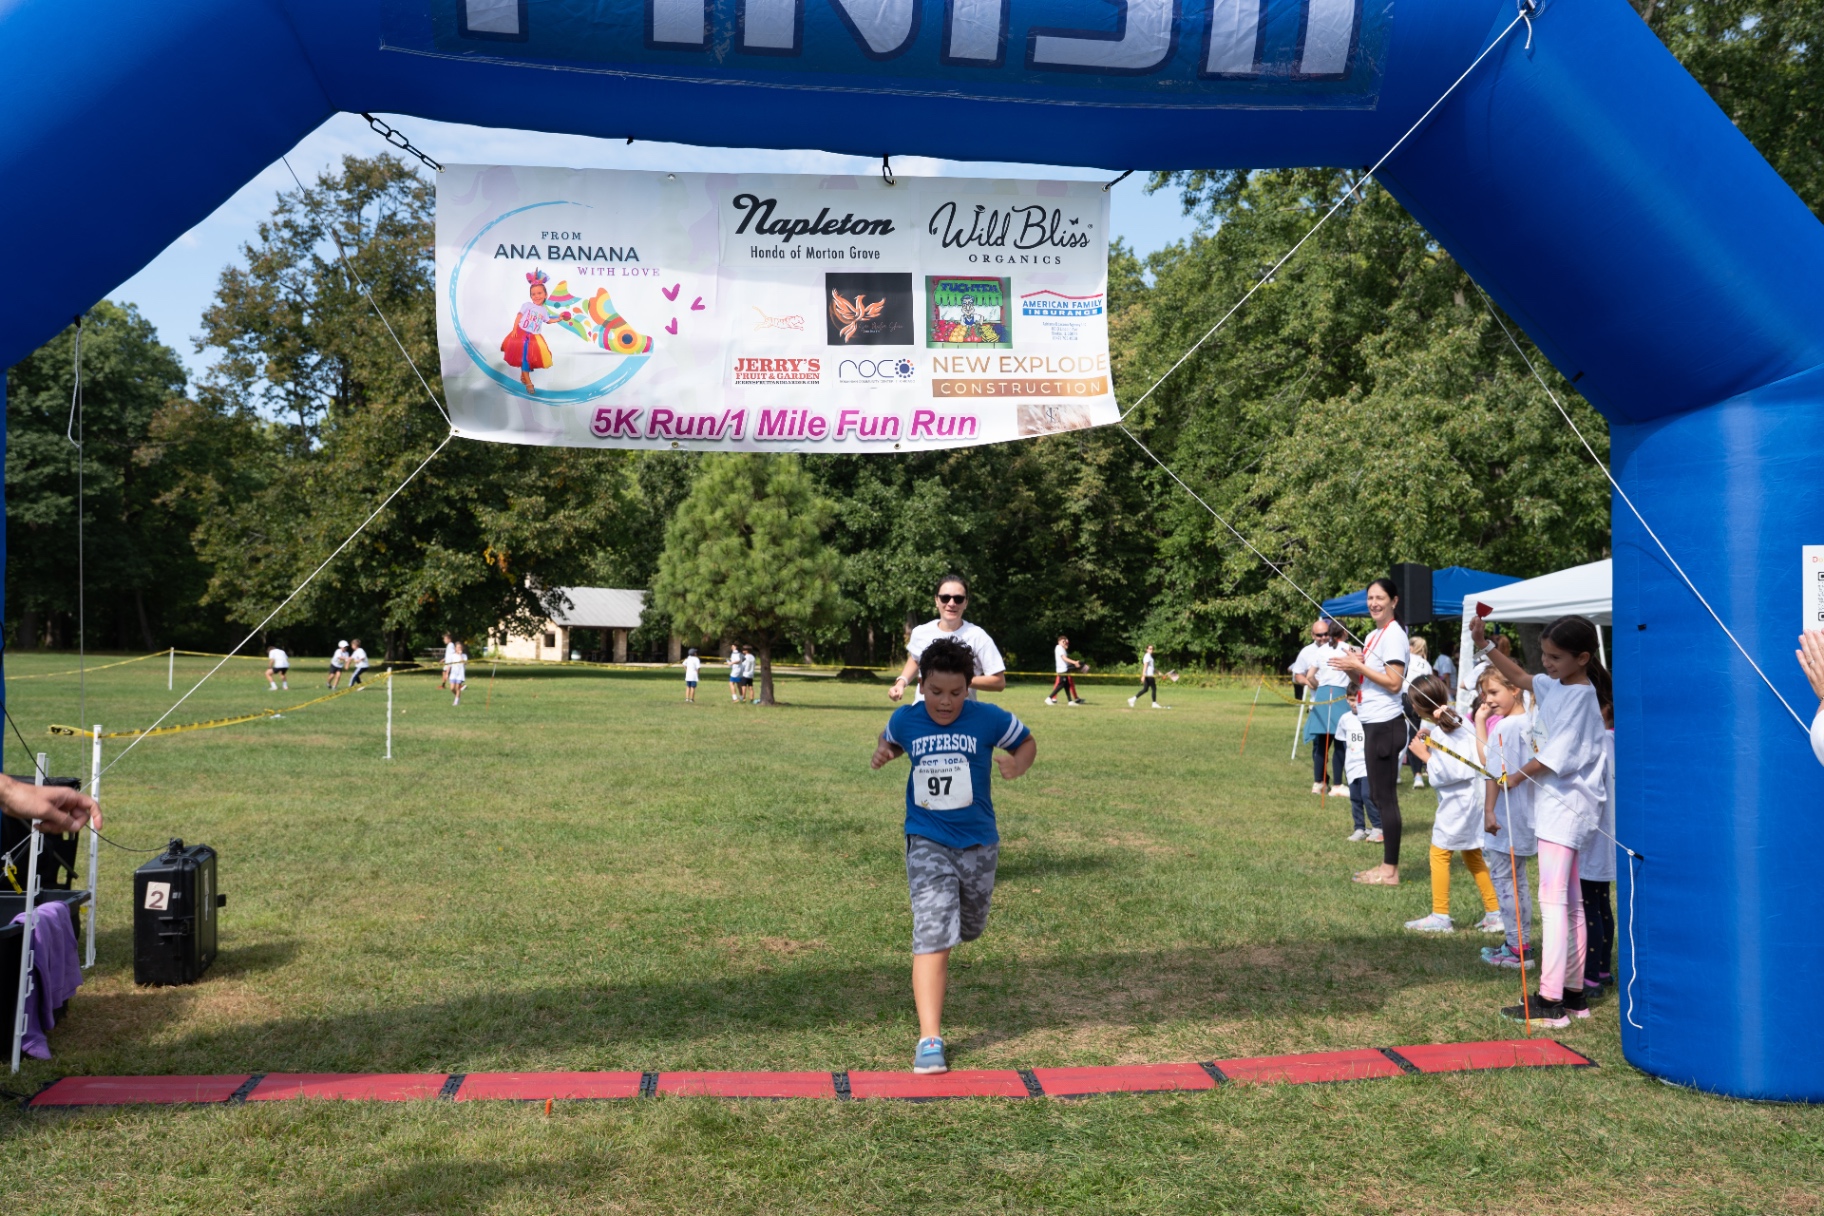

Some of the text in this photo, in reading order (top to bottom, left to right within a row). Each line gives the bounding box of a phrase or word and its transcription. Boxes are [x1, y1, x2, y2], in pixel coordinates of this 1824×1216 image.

[732, 193, 896, 243] Napleton
[928, 201, 1091, 250] Wild Bliss
[541, 231, 582, 241] FROM
[494, 243, 640, 262] ANA BANANA
[750, 245, 881, 260] Honda of Morton Grove
[968, 254, 1061, 265] ORGANICS
[577, 266, 660, 277] WITH LOVE
[1022, 299, 1103, 309] AMERICAN FAMILY
[1028, 308, 1098, 316] INSURANCE
[734, 357, 821, 372] JERRY'S
[932, 353, 1107, 374] NEW EXPLODE
[735, 372, 767, 380] FRUIT
[940, 381, 1101, 395] CONSTRUCTION
[593, 408, 978, 437] 5K Run/1 Mile Fun Run
[1351, 732, 1364, 742] 86
[911, 733, 978, 758] JEFFERSON
[927, 775, 953, 797] 97
[148, 890, 165, 909] 2
